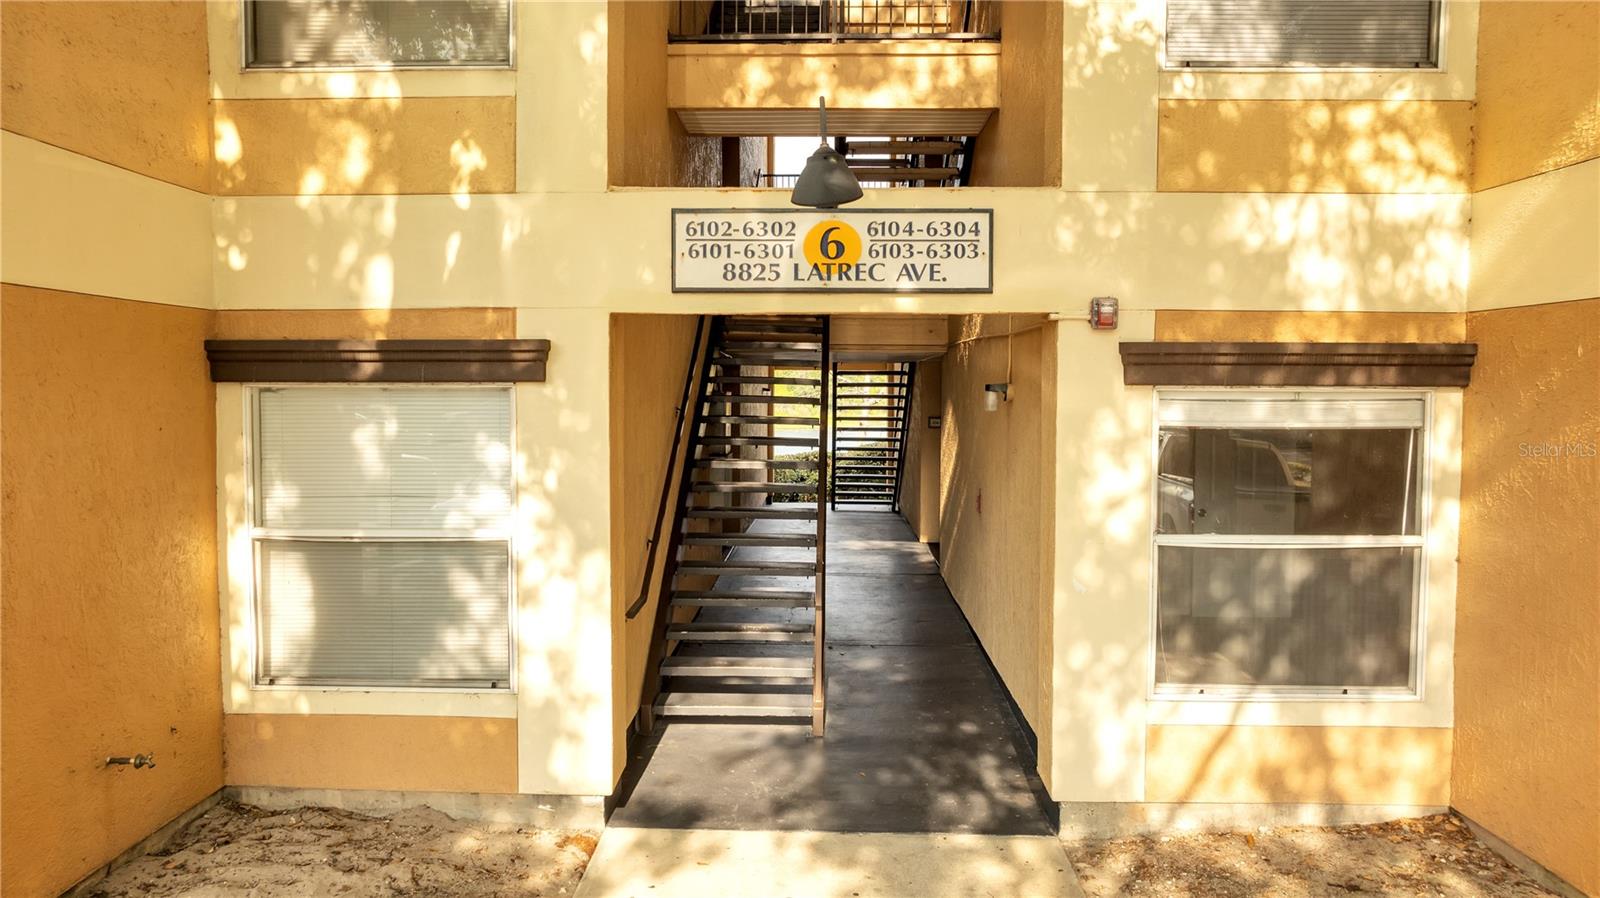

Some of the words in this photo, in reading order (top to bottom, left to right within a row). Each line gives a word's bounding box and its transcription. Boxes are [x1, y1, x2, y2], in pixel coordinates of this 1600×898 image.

[685, 221, 797, 237] 6102-6302
[866, 220, 981, 237] 6104-6304
[687, 243, 795, 259] 6101-6301
[819, 226, 846, 260] 6
[868, 243, 979, 259] 6103-6303
[722, 263, 781, 281] 8825
[793, 262, 886, 282] LATREC
[896, 263, 948, 282] AVE.
